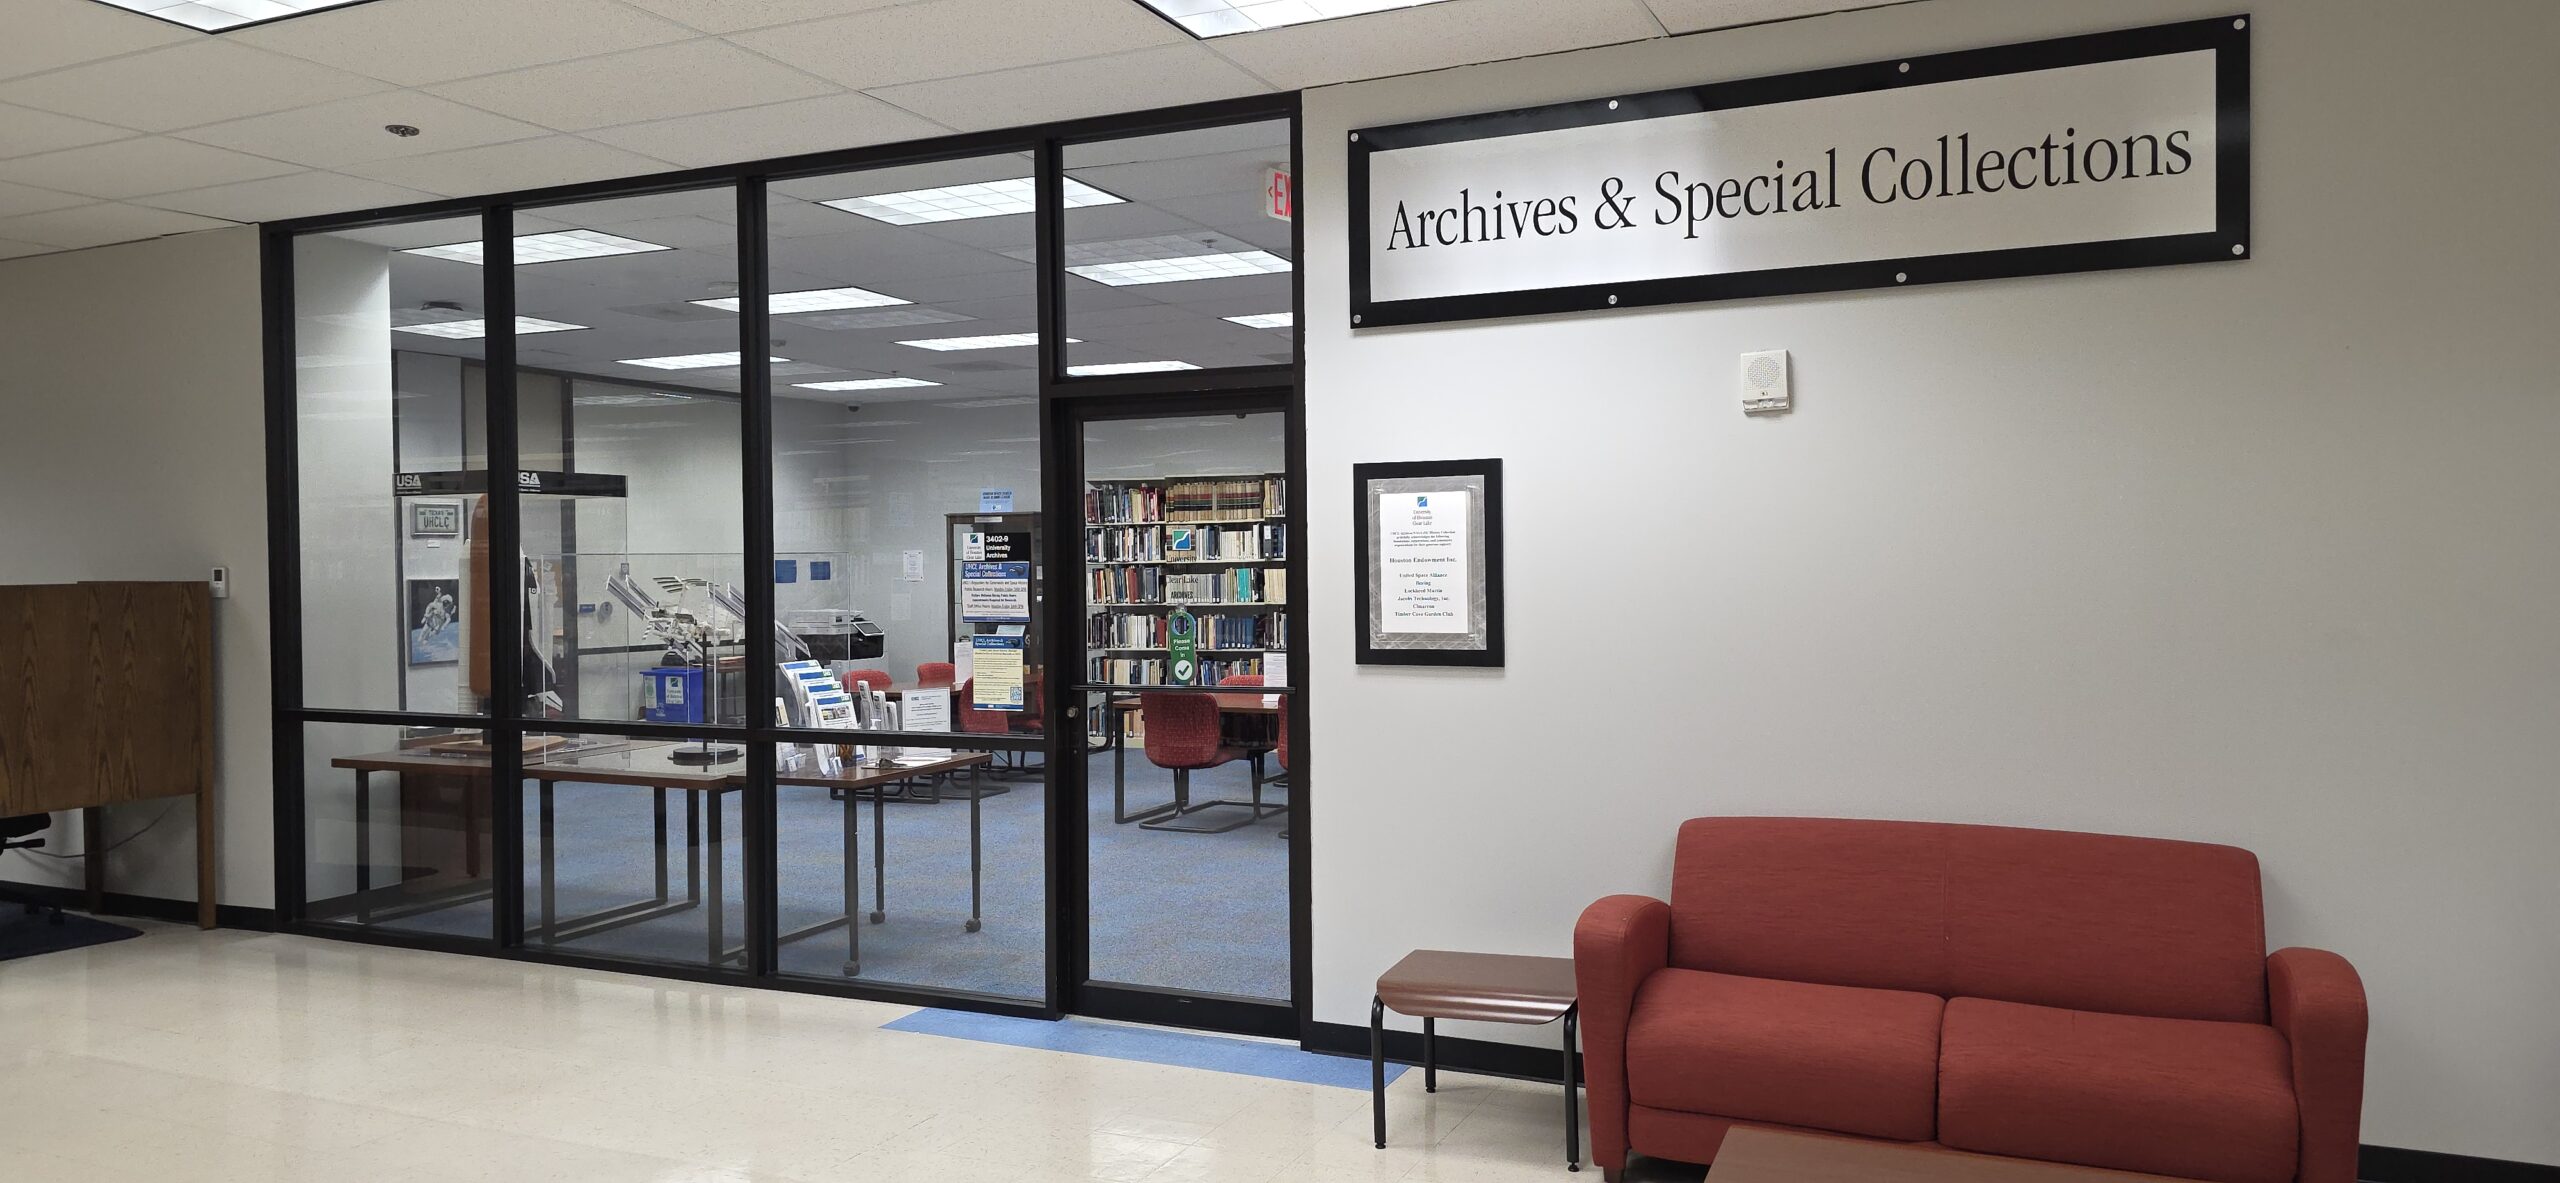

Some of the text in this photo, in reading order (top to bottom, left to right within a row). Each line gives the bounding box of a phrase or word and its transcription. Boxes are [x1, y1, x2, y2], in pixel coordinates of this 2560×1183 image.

[1274, 172, 1291, 217] EX
[1387, 128, 2191, 250] Archives & Special Collections
[396, 474, 422, 487] USA
[518, 472, 541, 485] SA
[986, 535, 1009, 543] 3402-9
[964, 570, 981, 578] Special
[1184, 575, 1199, 583] Lake
